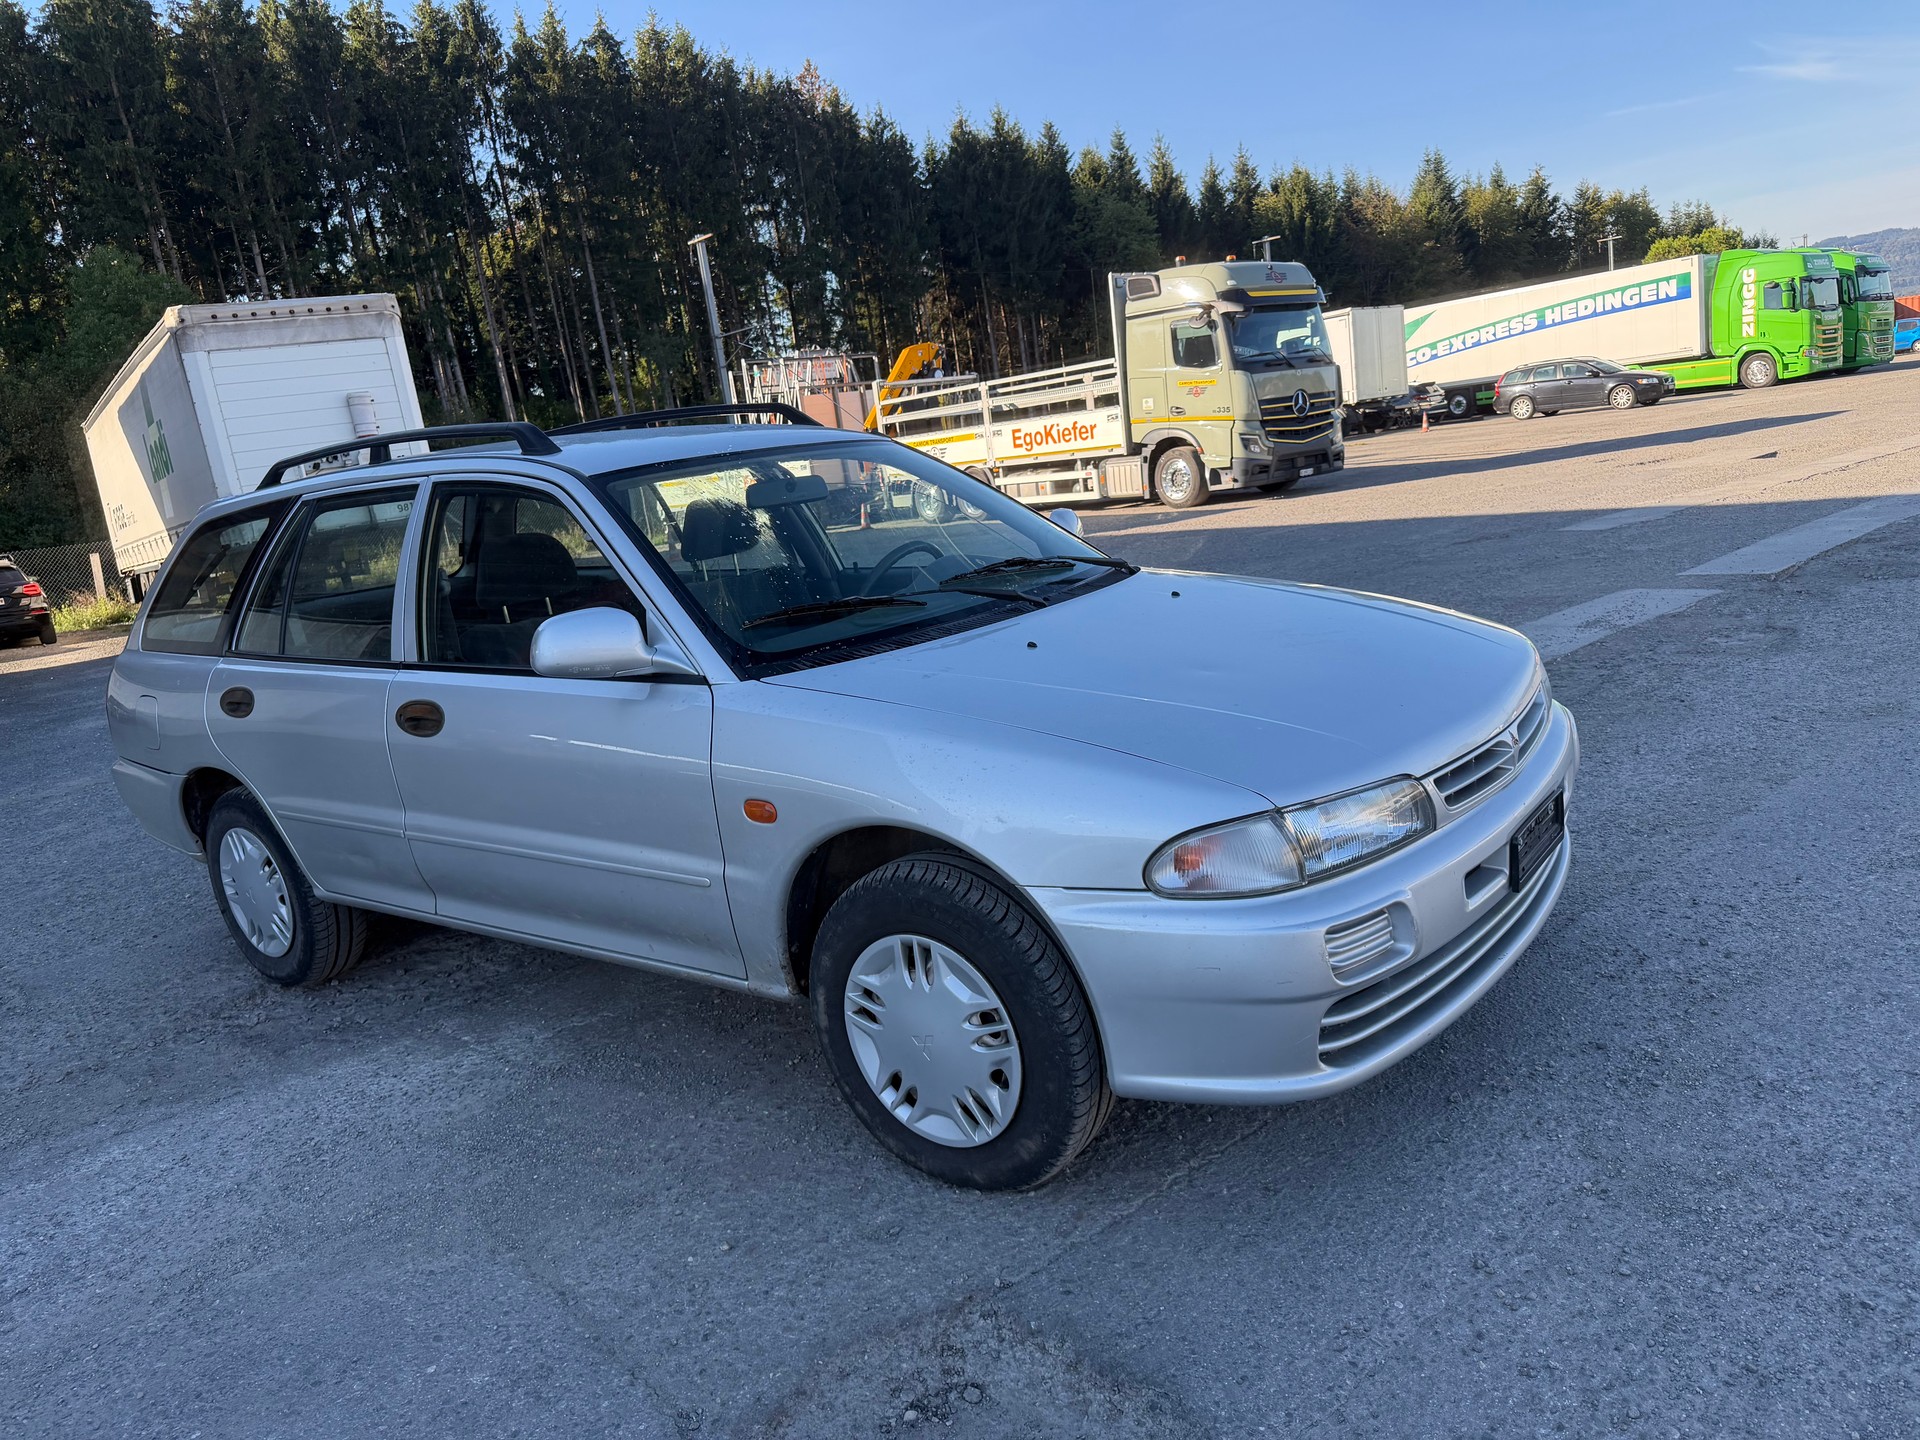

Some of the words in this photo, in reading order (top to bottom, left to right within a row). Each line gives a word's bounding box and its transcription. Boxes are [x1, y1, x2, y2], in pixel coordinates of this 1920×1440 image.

[1545, 279, 1678, 326] HEDINGEN
[1742, 268, 1756, 338] ZINGG
[930, 437, 954, 446] TRANSPORT
[1012, 421, 1097, 452] EgoKiefer
